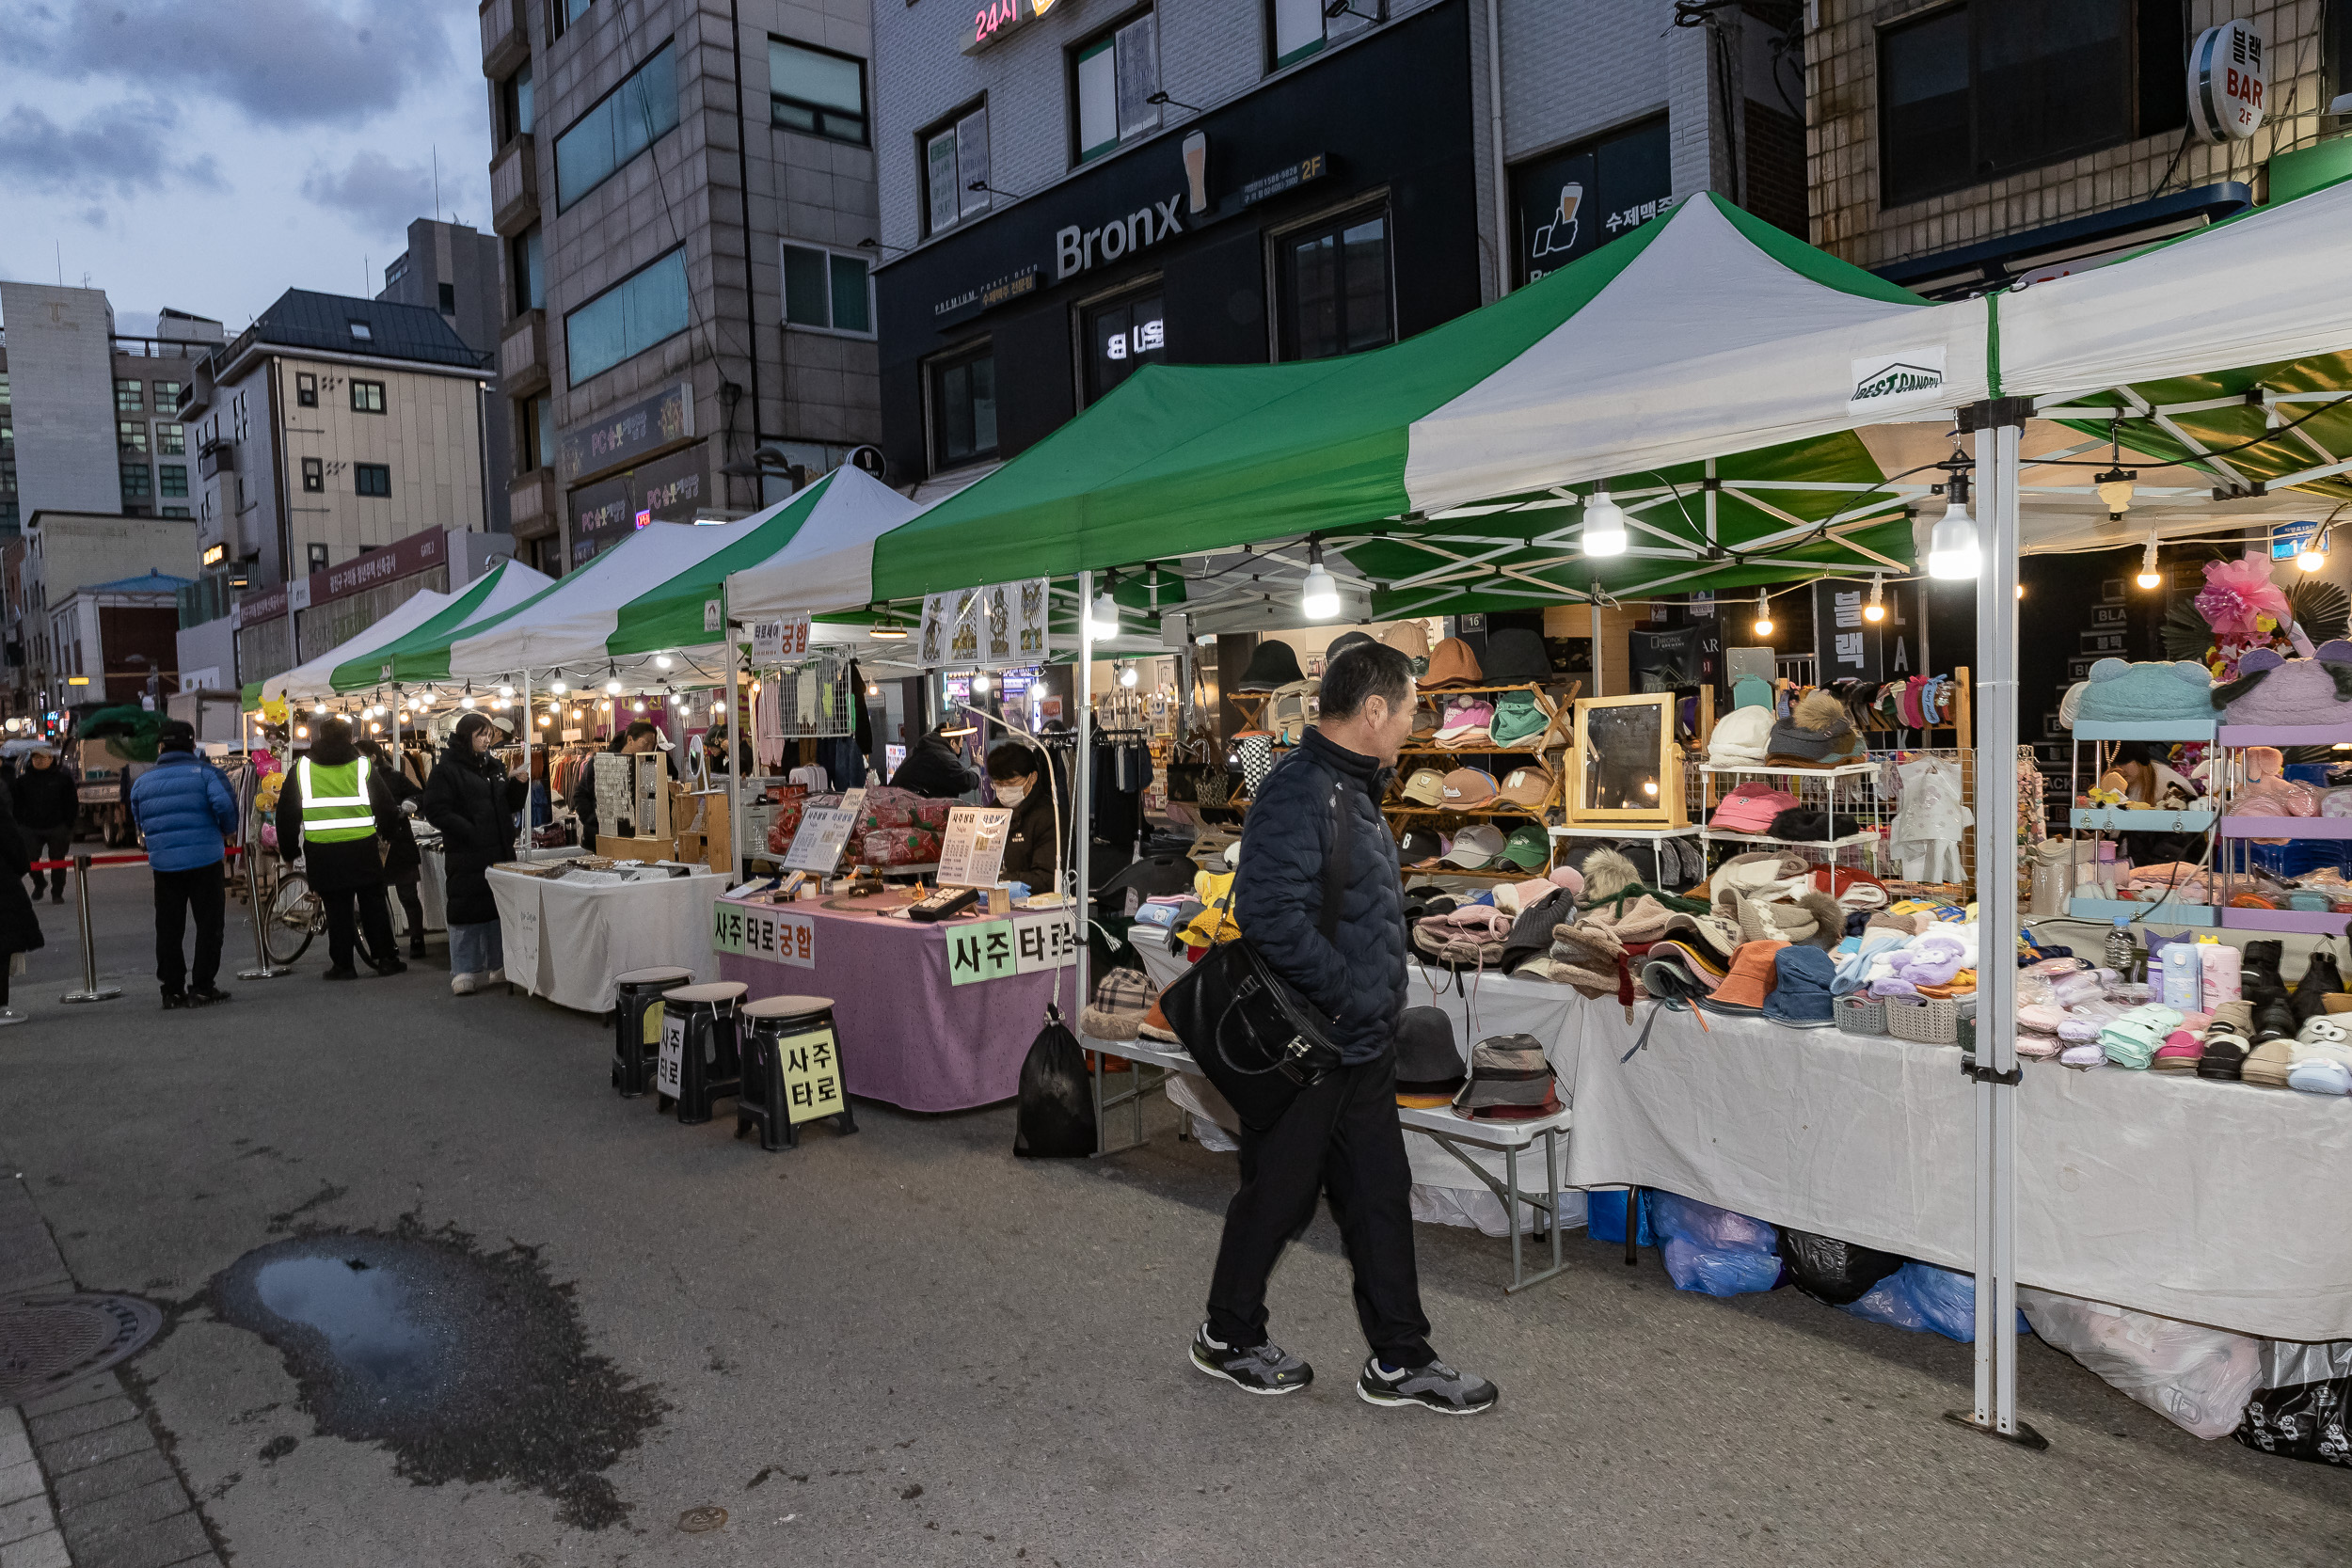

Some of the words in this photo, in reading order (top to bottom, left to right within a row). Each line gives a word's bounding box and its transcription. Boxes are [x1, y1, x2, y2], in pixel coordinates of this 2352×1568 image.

[976, 0, 1016, 42] 24시
[2233, 25, 2262, 74] 블랙
[2226, 68, 2264, 110] BAR
[2239, 107, 2252, 126] 2F
[1302, 156, 1321, 181] 2F
[1056, 194, 1183, 280] Bronx
[1854, 372, 1899, 400] BEST
[1896, 372, 1939, 394] CANOPY
[1469, 615, 1480, 626] 16
[1834, 591, 1865, 670] 블랙
[1507, 770, 1526, 789] N
[1402, 832, 1412, 849] B
[715, 911, 741, 947] 사주
[746, 916, 774, 952] 타로
[779, 923, 812, 960] 궁합
[954, 930, 1010, 974] 사주
[1019, 921, 1073, 962] 타로
[661, 1024, 680, 1054] 사주
[660, 1057, 678, 1086] 타로
[787, 1041, 832, 1073] 사주
[791, 1075, 837, 1108] 타로
